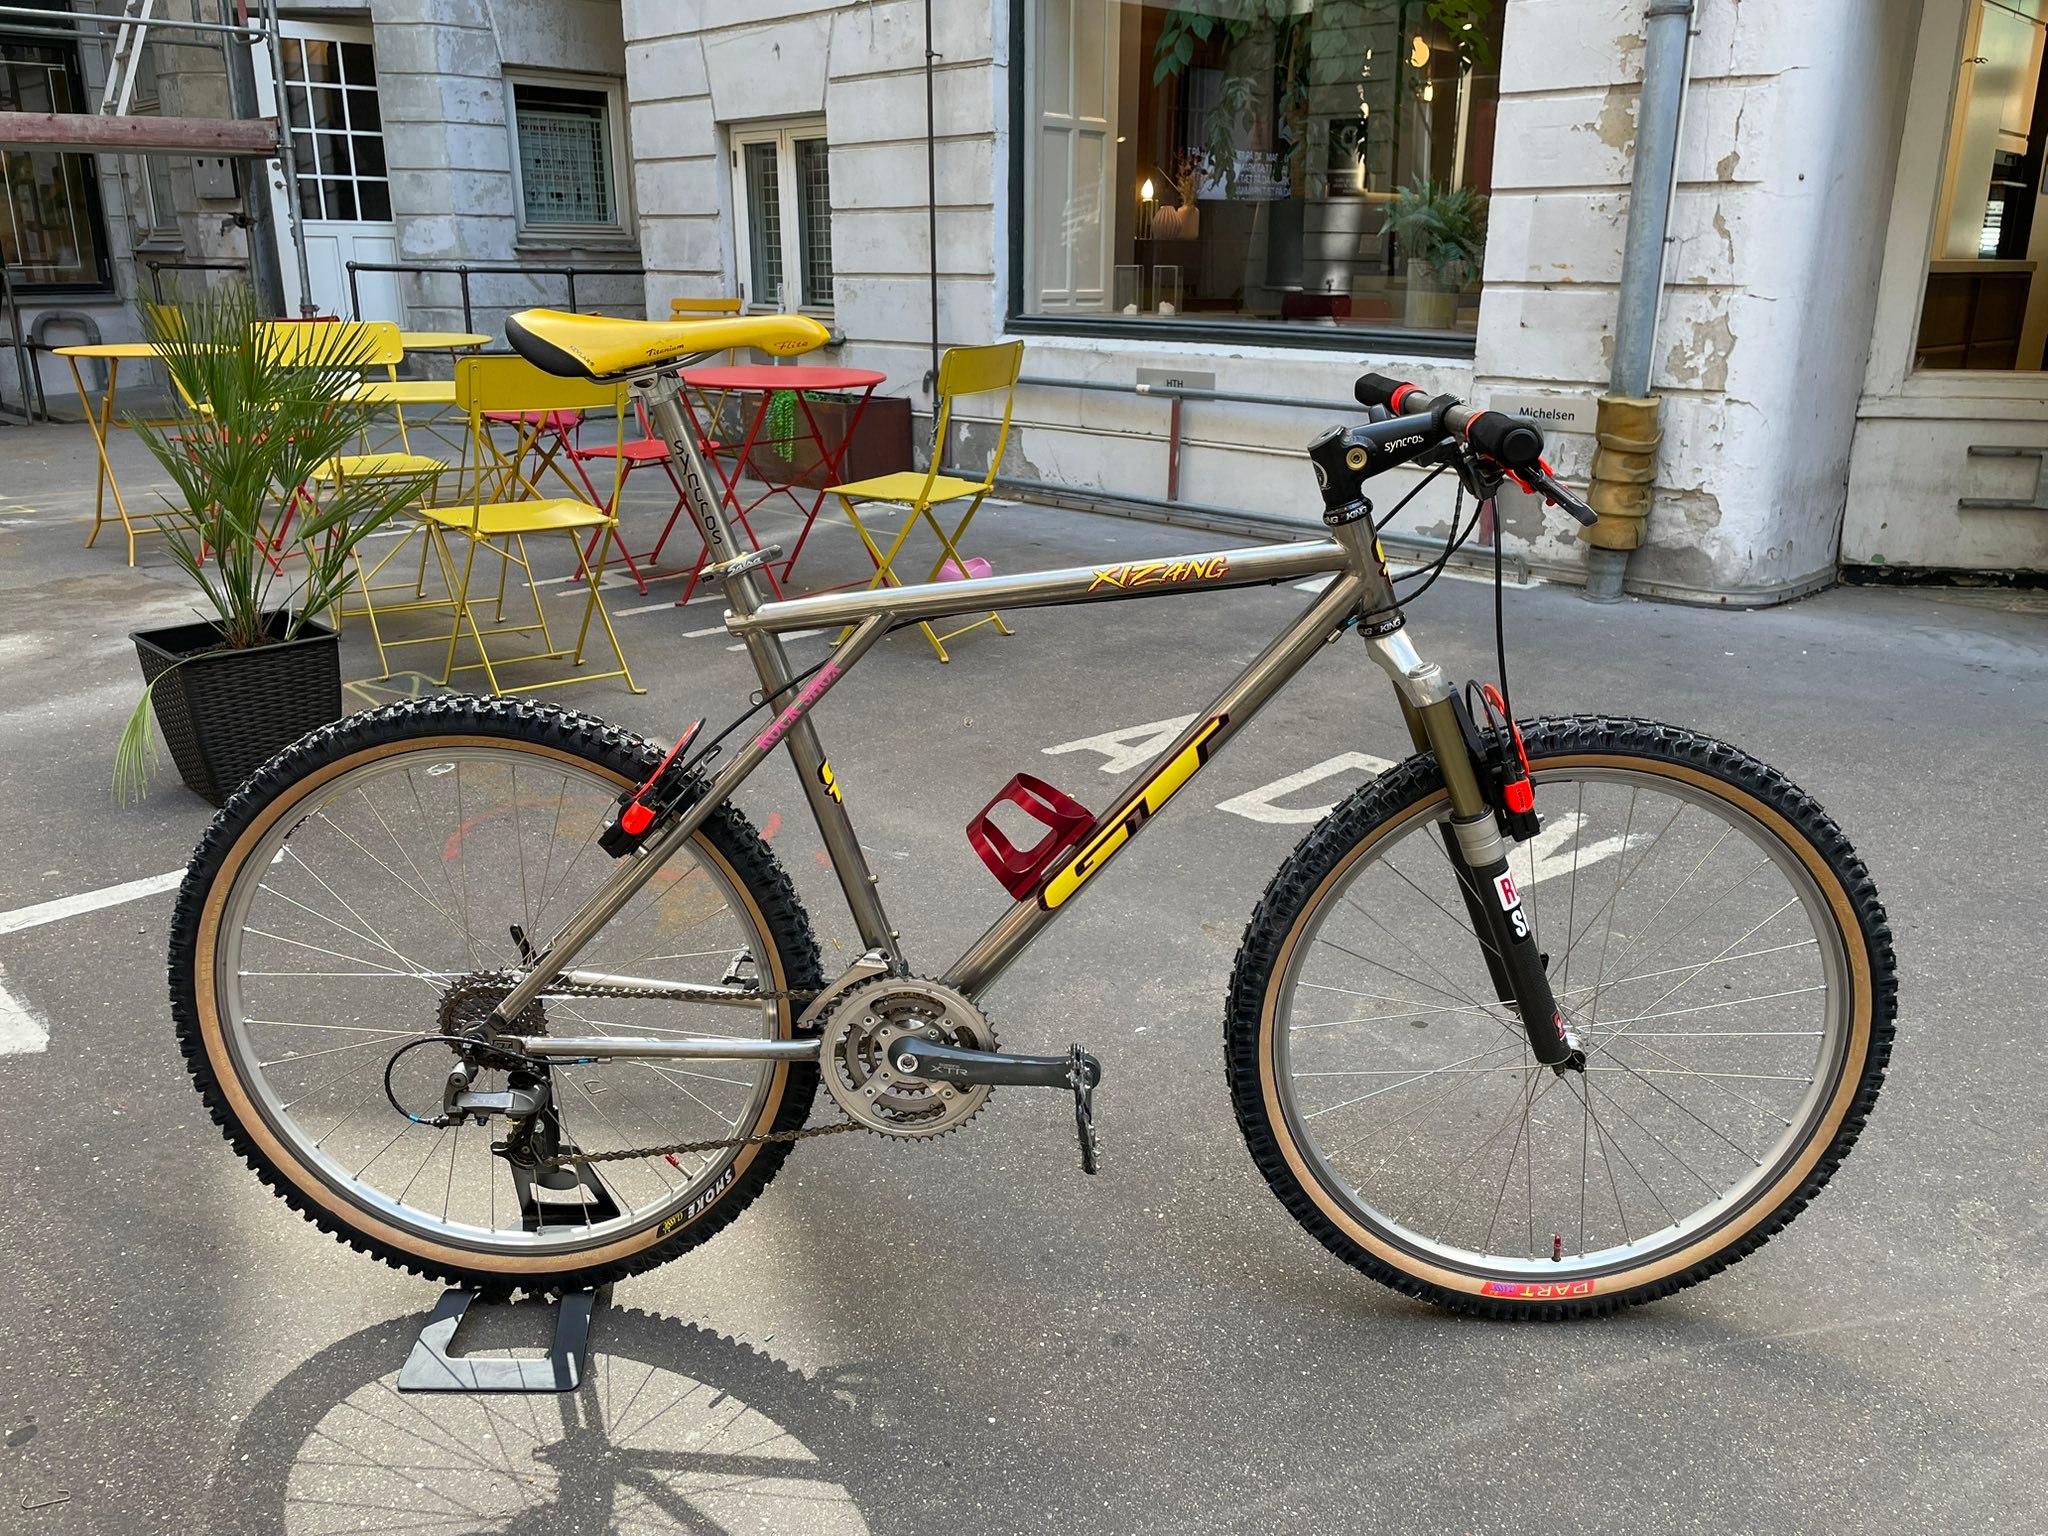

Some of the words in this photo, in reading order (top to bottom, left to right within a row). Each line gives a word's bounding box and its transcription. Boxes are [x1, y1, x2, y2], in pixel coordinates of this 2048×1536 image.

[646, 344, 685, 357] Titanium
[1166, 379, 1184, 388] HTH
[1519, 407, 1575, 421] Michelsen
[1383, 434, 1425, 453] syncros
[1346, 505, 1368, 520] KING
[726, 556, 765, 578] Salsa
[1087, 556, 1230, 592] XIZANG
[1380, 617, 1401, 633] KING
[756, 705, 802, 751] ROCK
[798, 660, 843, 706] SHOX
[1037, 713, 1230, 911] GT
[930, 1064, 969, 1076] XTR
[687, 1168, 733, 1219] SMOKE
[1519, 1282, 1589, 1297] DART
